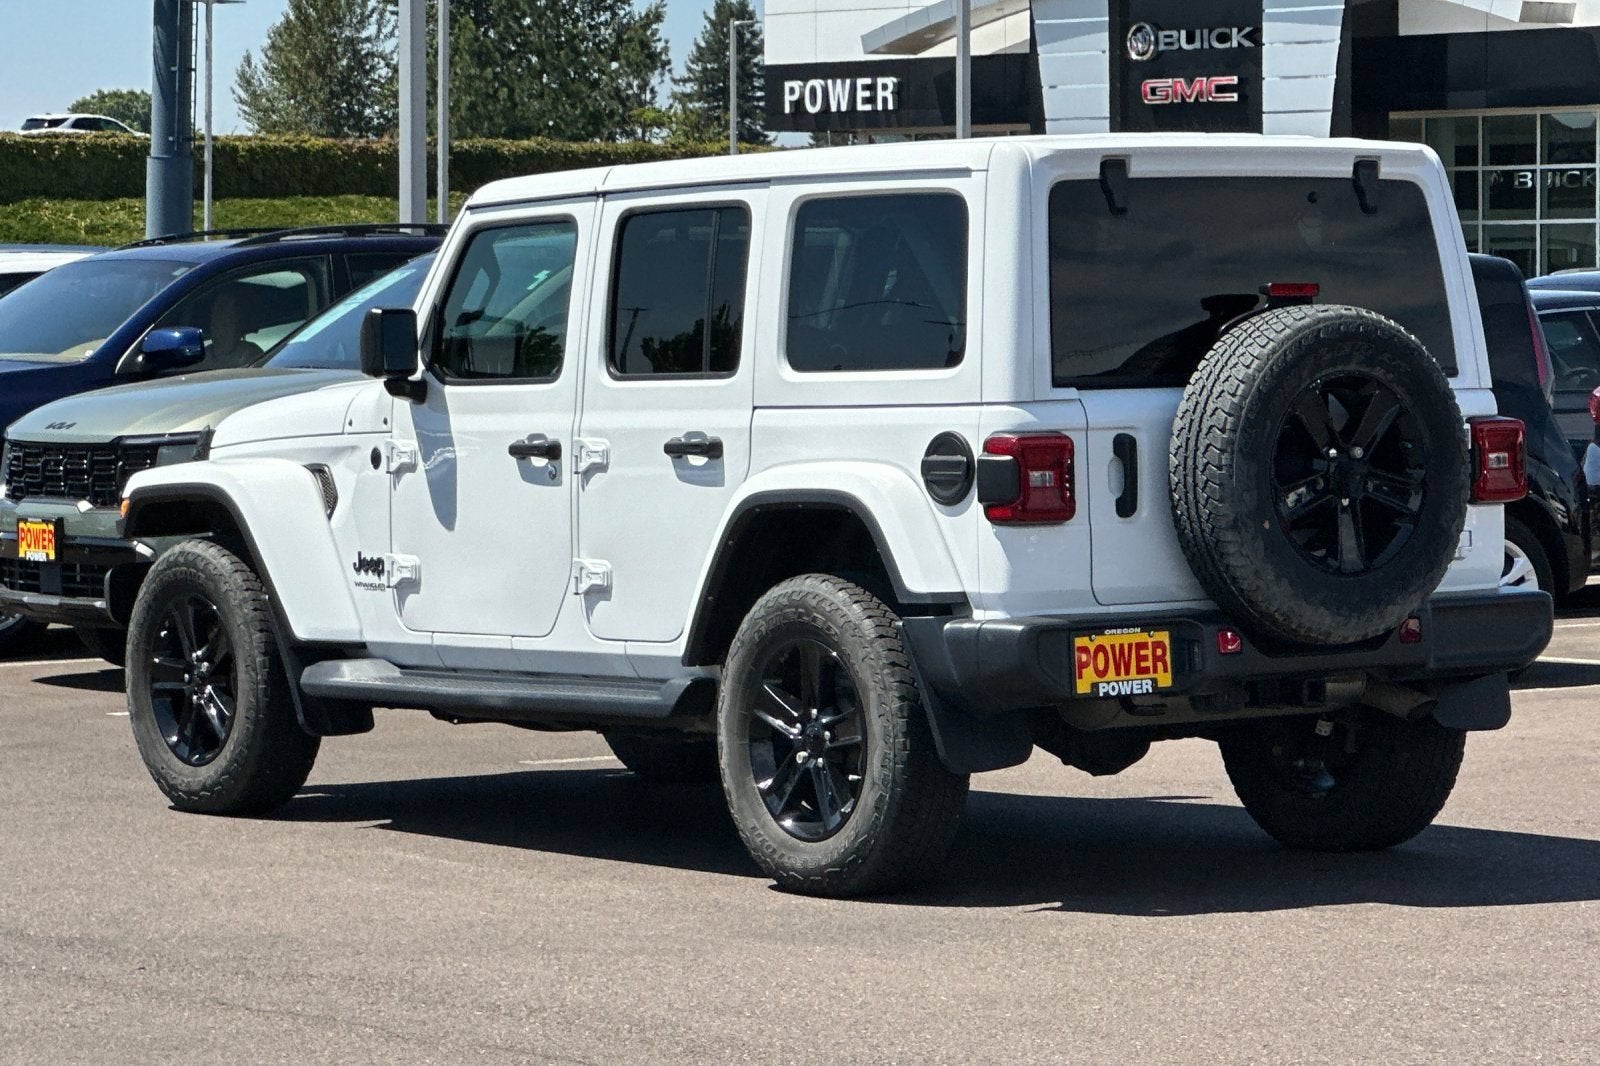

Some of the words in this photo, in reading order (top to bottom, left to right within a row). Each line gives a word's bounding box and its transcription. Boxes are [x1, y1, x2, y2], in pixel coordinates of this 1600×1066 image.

[1158, 27, 1255, 51] BUICK
[784, 76, 897, 114] POWER
[1141, 76, 1239, 104] GMC
[19, 527, 54, 550] POWER
[353, 551, 385, 581] Jeep
[1104, 627, 1141, 636] OREGON
[1077, 640, 1169, 680] POWER
[1099, 679, 1152, 697] POWER
